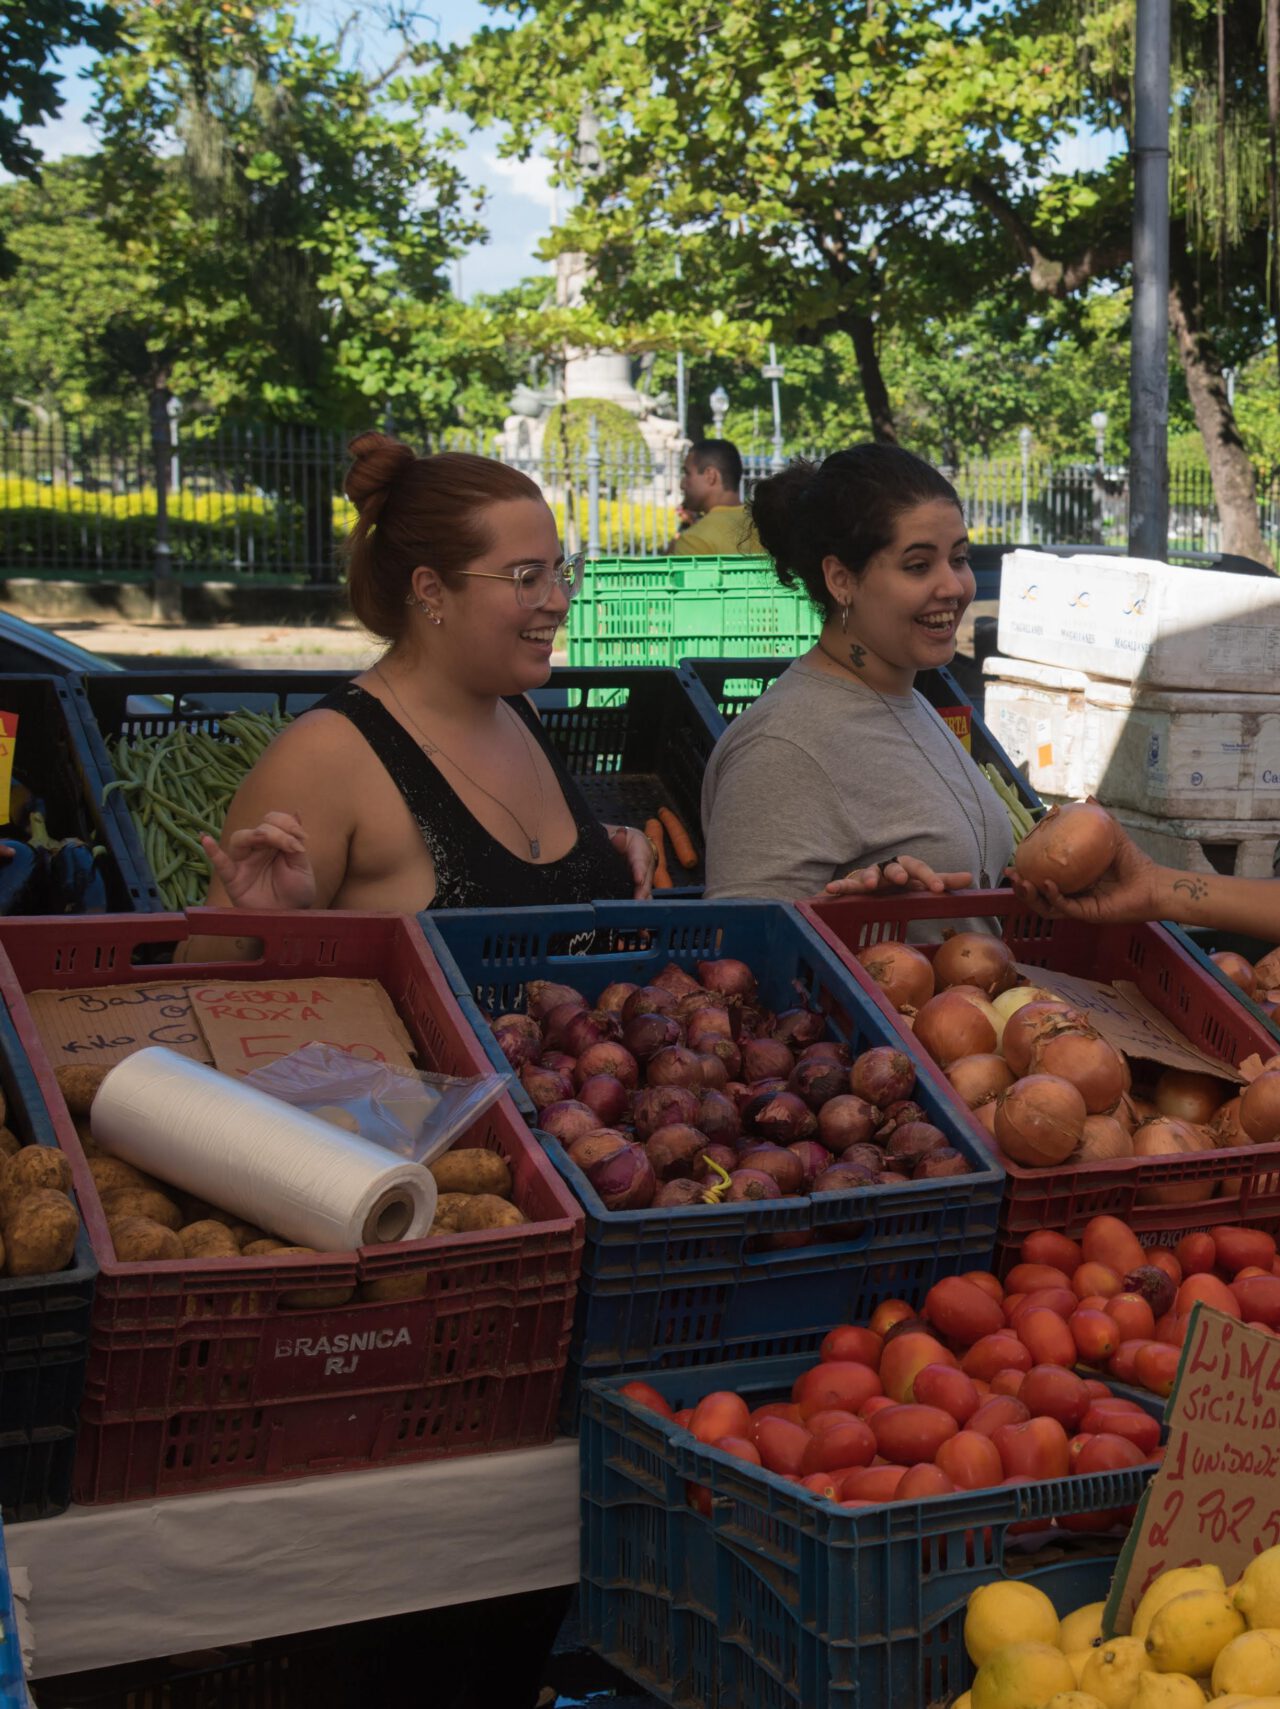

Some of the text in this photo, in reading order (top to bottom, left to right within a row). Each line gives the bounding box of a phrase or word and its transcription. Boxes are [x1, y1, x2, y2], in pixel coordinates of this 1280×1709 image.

[196, 989, 334, 1004] CEBOLA
[205, 1005, 325, 1021] ROXA
[274, 1326, 412, 1360] BRASNICA
[324, 1354, 360, 1376] RJ
